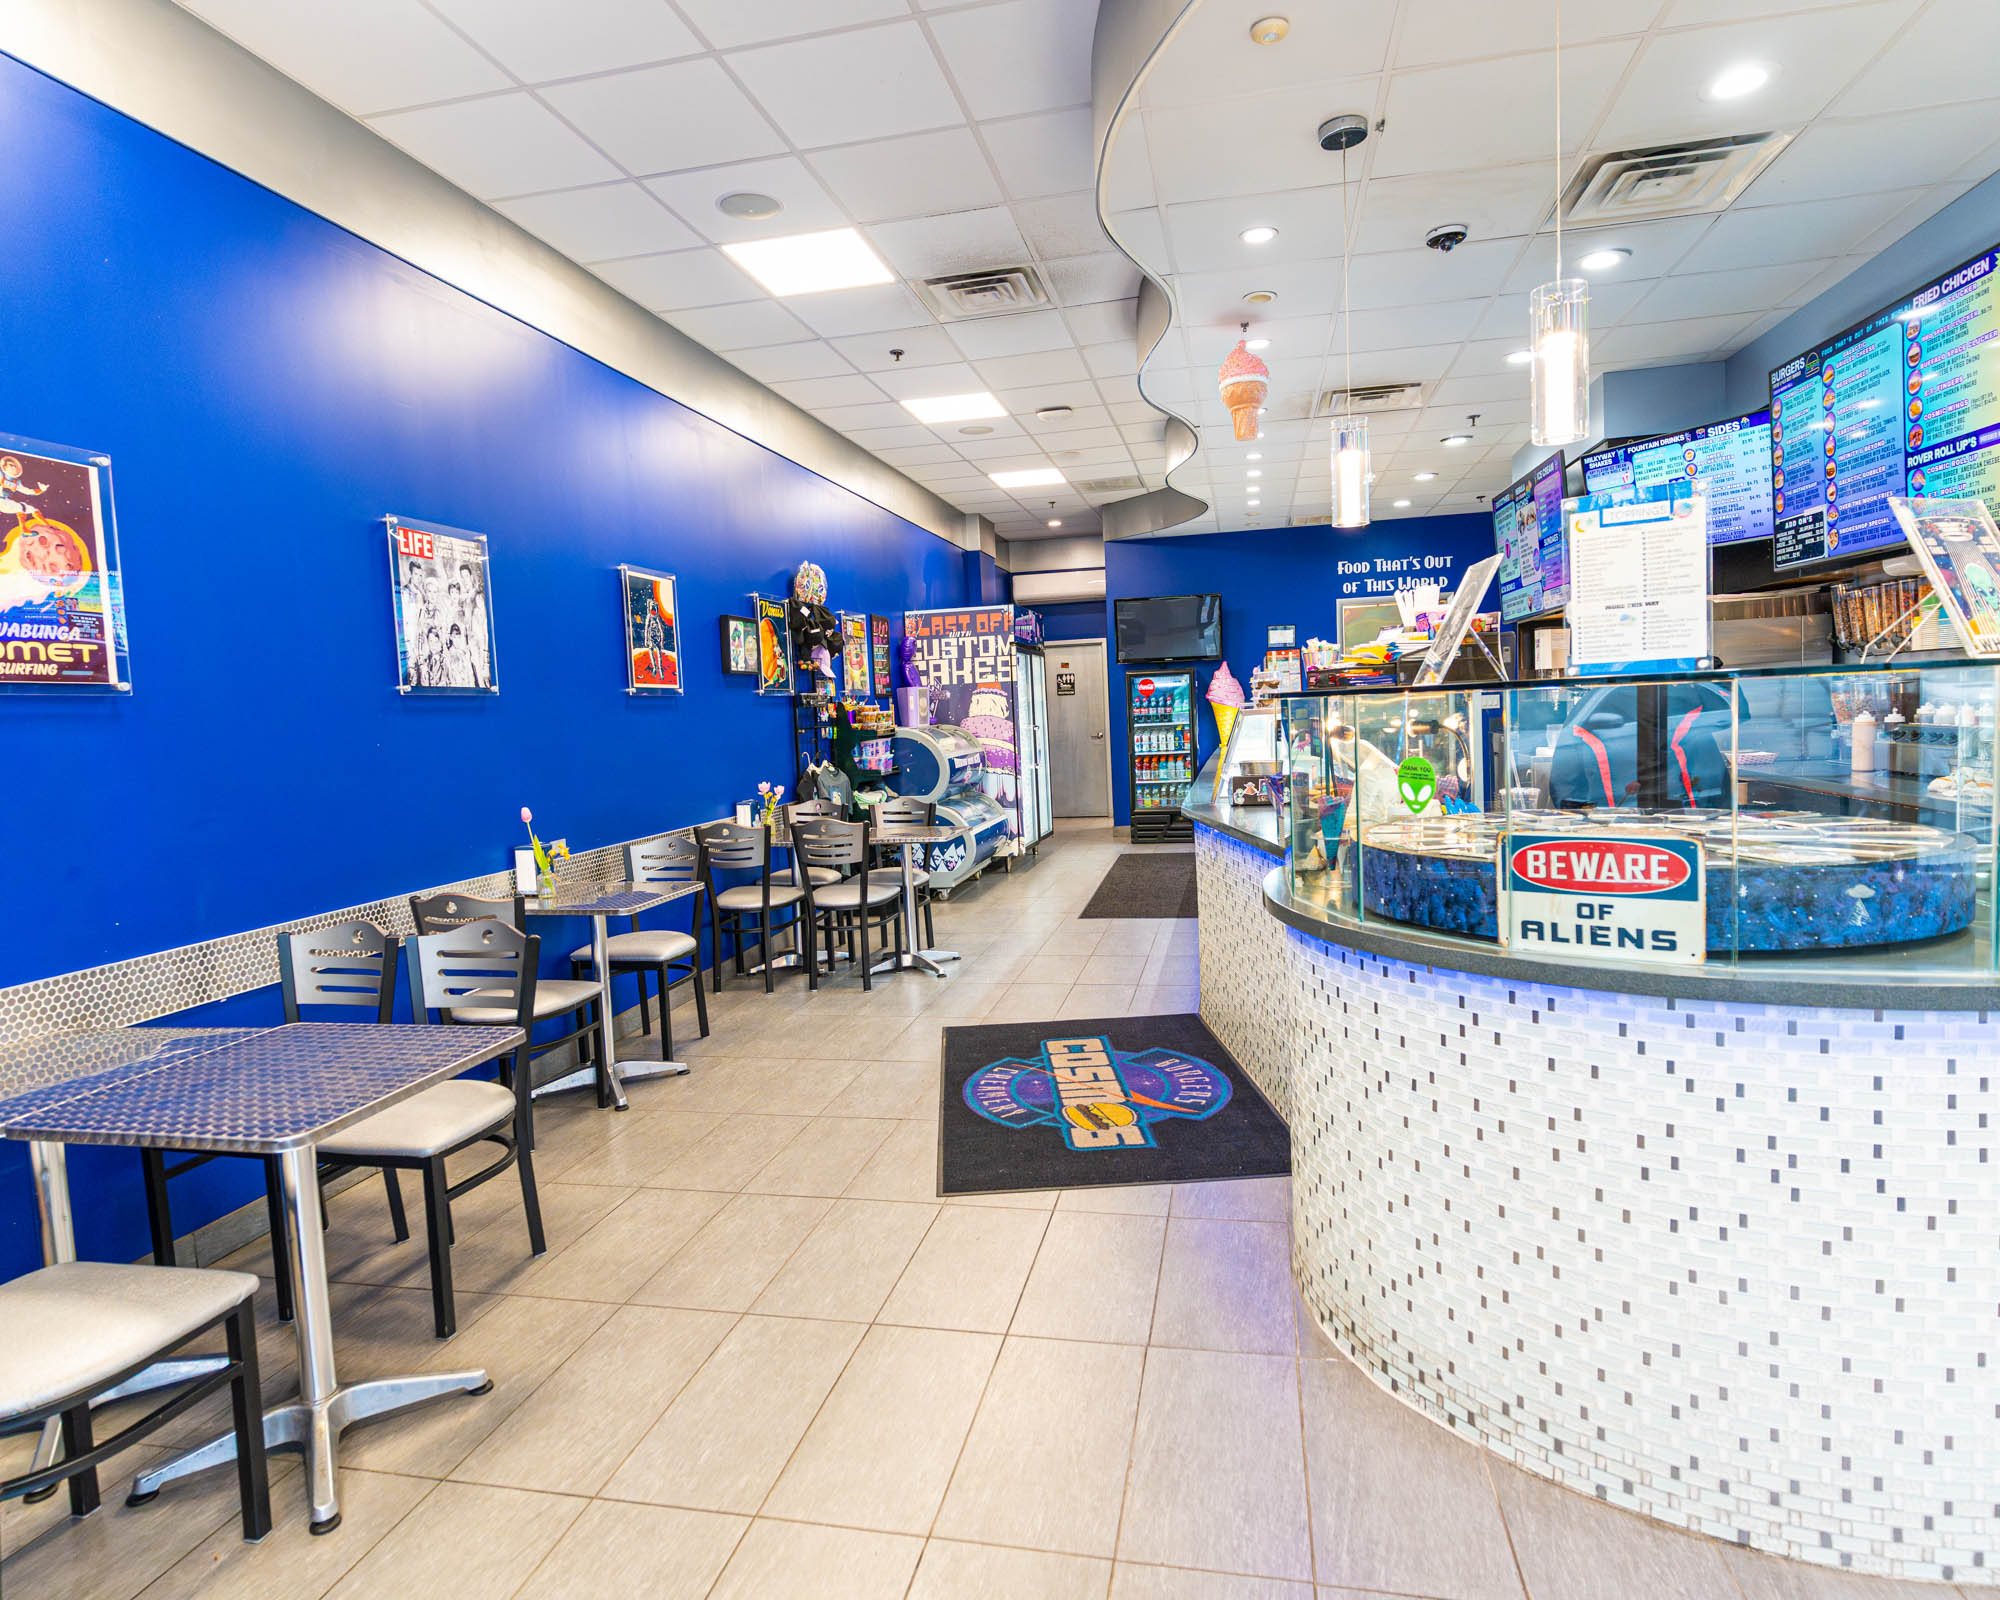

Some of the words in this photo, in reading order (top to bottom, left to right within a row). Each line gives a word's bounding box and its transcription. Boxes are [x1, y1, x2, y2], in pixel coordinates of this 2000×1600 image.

[1913, 285, 1940, 310] FRIED
[1942, 257, 1990, 294] CHICKEN
[1856, 344, 1876, 360] CHEESE
[1920, 354, 1946, 369] BUFFALO
[1947, 344, 1966, 358] SPACE
[1968, 329, 1998, 348] CLUCKER
[1771, 357, 1806, 385] BURGERS
[1937, 374, 1964, 391] FINGERS
[1924, 408, 1946, 420] COSMIC
[1948, 398, 1969, 412] WINGS
[1708, 422, 1740, 437] SIDES
[1627, 440, 1660, 454] FOUNTAIN
[1660, 434, 1684, 446] DRINKS
[1838, 448, 1858, 462] INFINITY
[1864, 440, 1886, 452] BEYOND
[1907, 450, 1934, 468] ROVER
[1934, 442, 1956, 460] ROLL
[1956, 436, 1977, 451] UP'S
[1584, 451, 1616, 464] MILKYWAY
[1589, 459, 1613, 469] SHAKES
[1927, 462, 1950, 474] COSMIC
[1952, 458, 1968, 467] ROLL
[1969, 452, 1978, 462] UP
[1839, 472, 1861, 486] GALACTIC
[1862, 465, 1886, 479] GOBBLER
[1839, 502, 1850, 510] OVER
[1852, 499, 1862, 508] THE
[1863, 495, 1877, 505] MOON
[1878, 490, 1893, 500] FRIES
[1940, 486, 1956, 496] ROLL
[1958, 483, 1967, 492] UP
[1610, 505, 1666, 521] TOPPINGS
[1785, 518, 1796, 529] ADD
[1798, 515, 1813, 525] ON'S
[1840, 522, 1867, 534] SMOKESHOP
[1869, 517, 1890, 528] SPECIAL
[399, 530, 432, 558] LIFE
[1543, 534, 1559, 546] SUNDAES
[760, 600, 784, 618] Venus
[906, 614, 970, 637] BLAST
[976, 612, 1013, 632] OFF
[913, 634, 1017, 660] CUSTOM
[915, 656, 1017, 686] CAKES
[1401, 764, 1417, 772] THANK
[1526, 850, 1670, 885] BEWARE
[1576, 902, 1614, 920] OF
[1521, 920, 1677, 951] ALIENS
[1155, 1058, 1206, 1106] BURGERS
[976, 1067, 1026, 1119] CREAMERY
